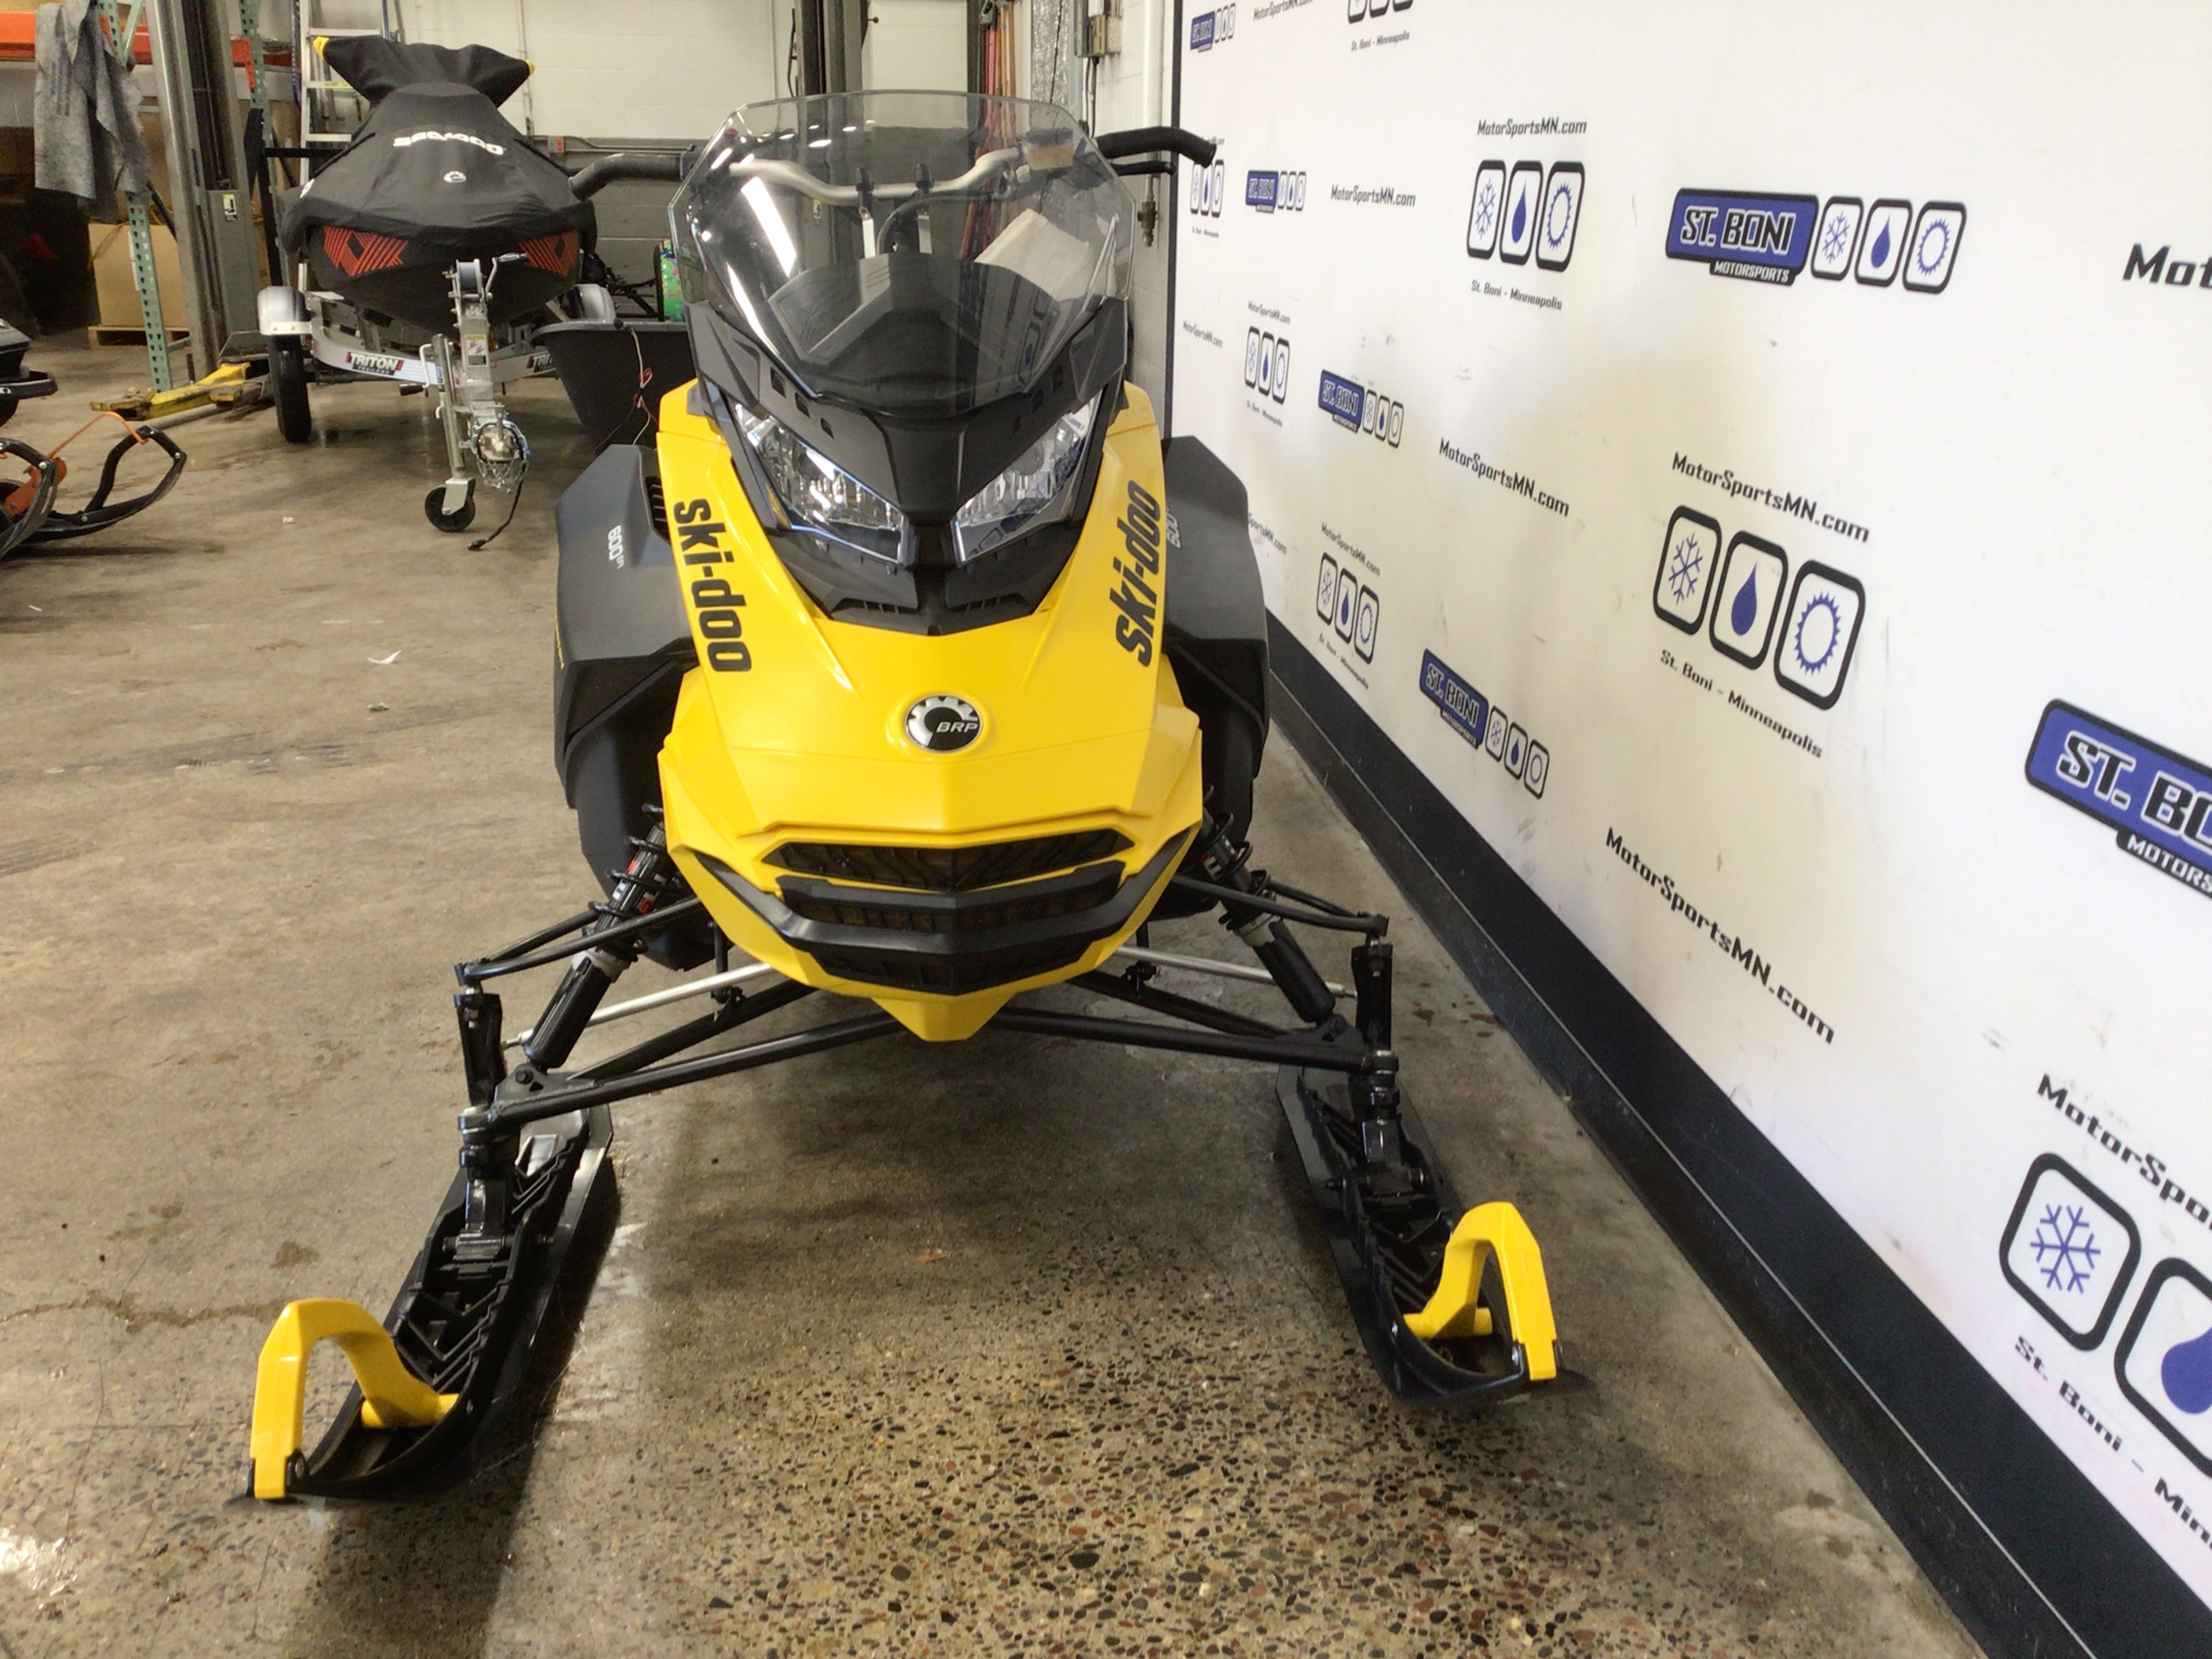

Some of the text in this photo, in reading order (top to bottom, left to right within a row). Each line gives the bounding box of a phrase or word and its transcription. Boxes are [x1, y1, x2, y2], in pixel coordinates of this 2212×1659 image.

[1477, 117, 1586, 138] MotorSportsMN.com
[1331, 185, 1416, 207] MotorSportsMN.com
[1680, 205, 1796, 255] ST. BONI
[1471, 279, 1481, 292] St.
[1483, 282, 1502, 297] Boni
[1510, 287, 1563, 310] Minneapolis
[1714, 260, 1790, 283] MOTORSPORTS
[350, 353, 398, 370] TRITON
[1439, 437, 1570, 516] MotorSportsMN.com
[1673, 453, 1870, 544] MotorSportsMN.com
[608, 525, 623, 561] 600
[1109, 480, 1160, 667] ski-doo
[1321, 521, 1380, 577] MotorSportsMN.com
[674, 499, 752, 672] ski-doo
[937, 722, 978, 733] BRP
[1426, 662, 1479, 729] ST. BONI
[1660, 649, 1678, 671] St.
[1682, 661, 1713, 691] Boni
[1727, 690, 1822, 759] Minneapolis
[2056, 730, 2137, 811] ST.
[1606, 827, 1835, 1044] MotorSportsMN.com
[2038, 1073, 2212, 1231] MotorSpo
[2015, 1334, 2048, 1382] St.
[2059, 1380, 2123, 1452] Boni
[2154, 1477, 2212, 1550] Min
